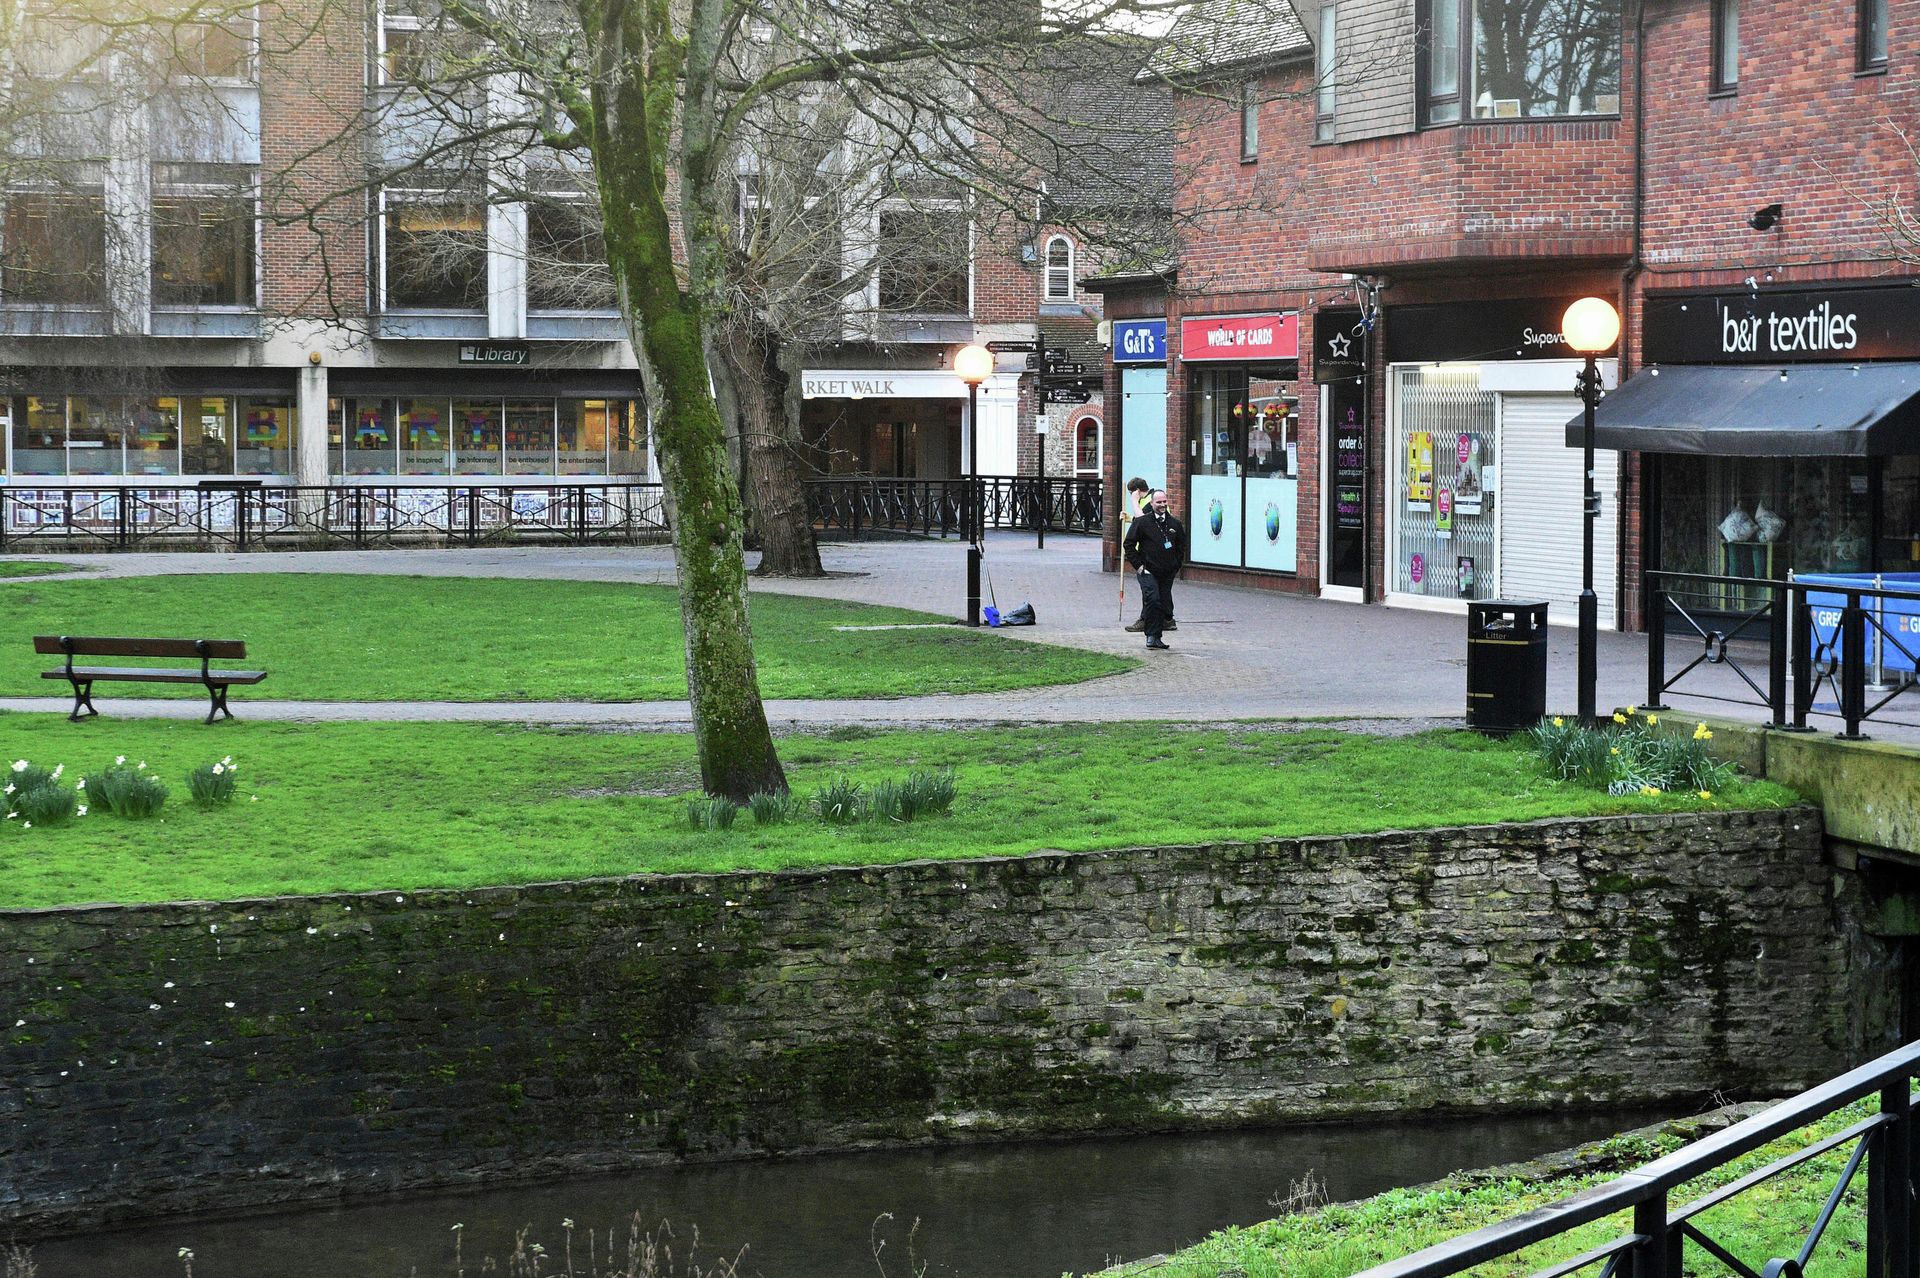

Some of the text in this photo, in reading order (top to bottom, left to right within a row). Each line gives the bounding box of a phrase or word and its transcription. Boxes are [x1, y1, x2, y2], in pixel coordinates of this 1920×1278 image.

[1722, 301, 1858, 352] b&r textiles
[1124, 328, 1155, 354] G&T's
[1207, 328, 1273, 347] WORLD OF CARDS
[475, 346, 527, 364] Library
[850, 380, 895, 395] WALK
[1338, 435, 1363, 450] order &
[406, 456, 443, 465] be inspired
[457, 456, 497, 464] be informed
[508, 456, 549, 464] be enthused
[559, 456, 606, 464] be entertained
[1338, 452, 1363, 468] collect
[1485, 631, 1507, 640] Litter
